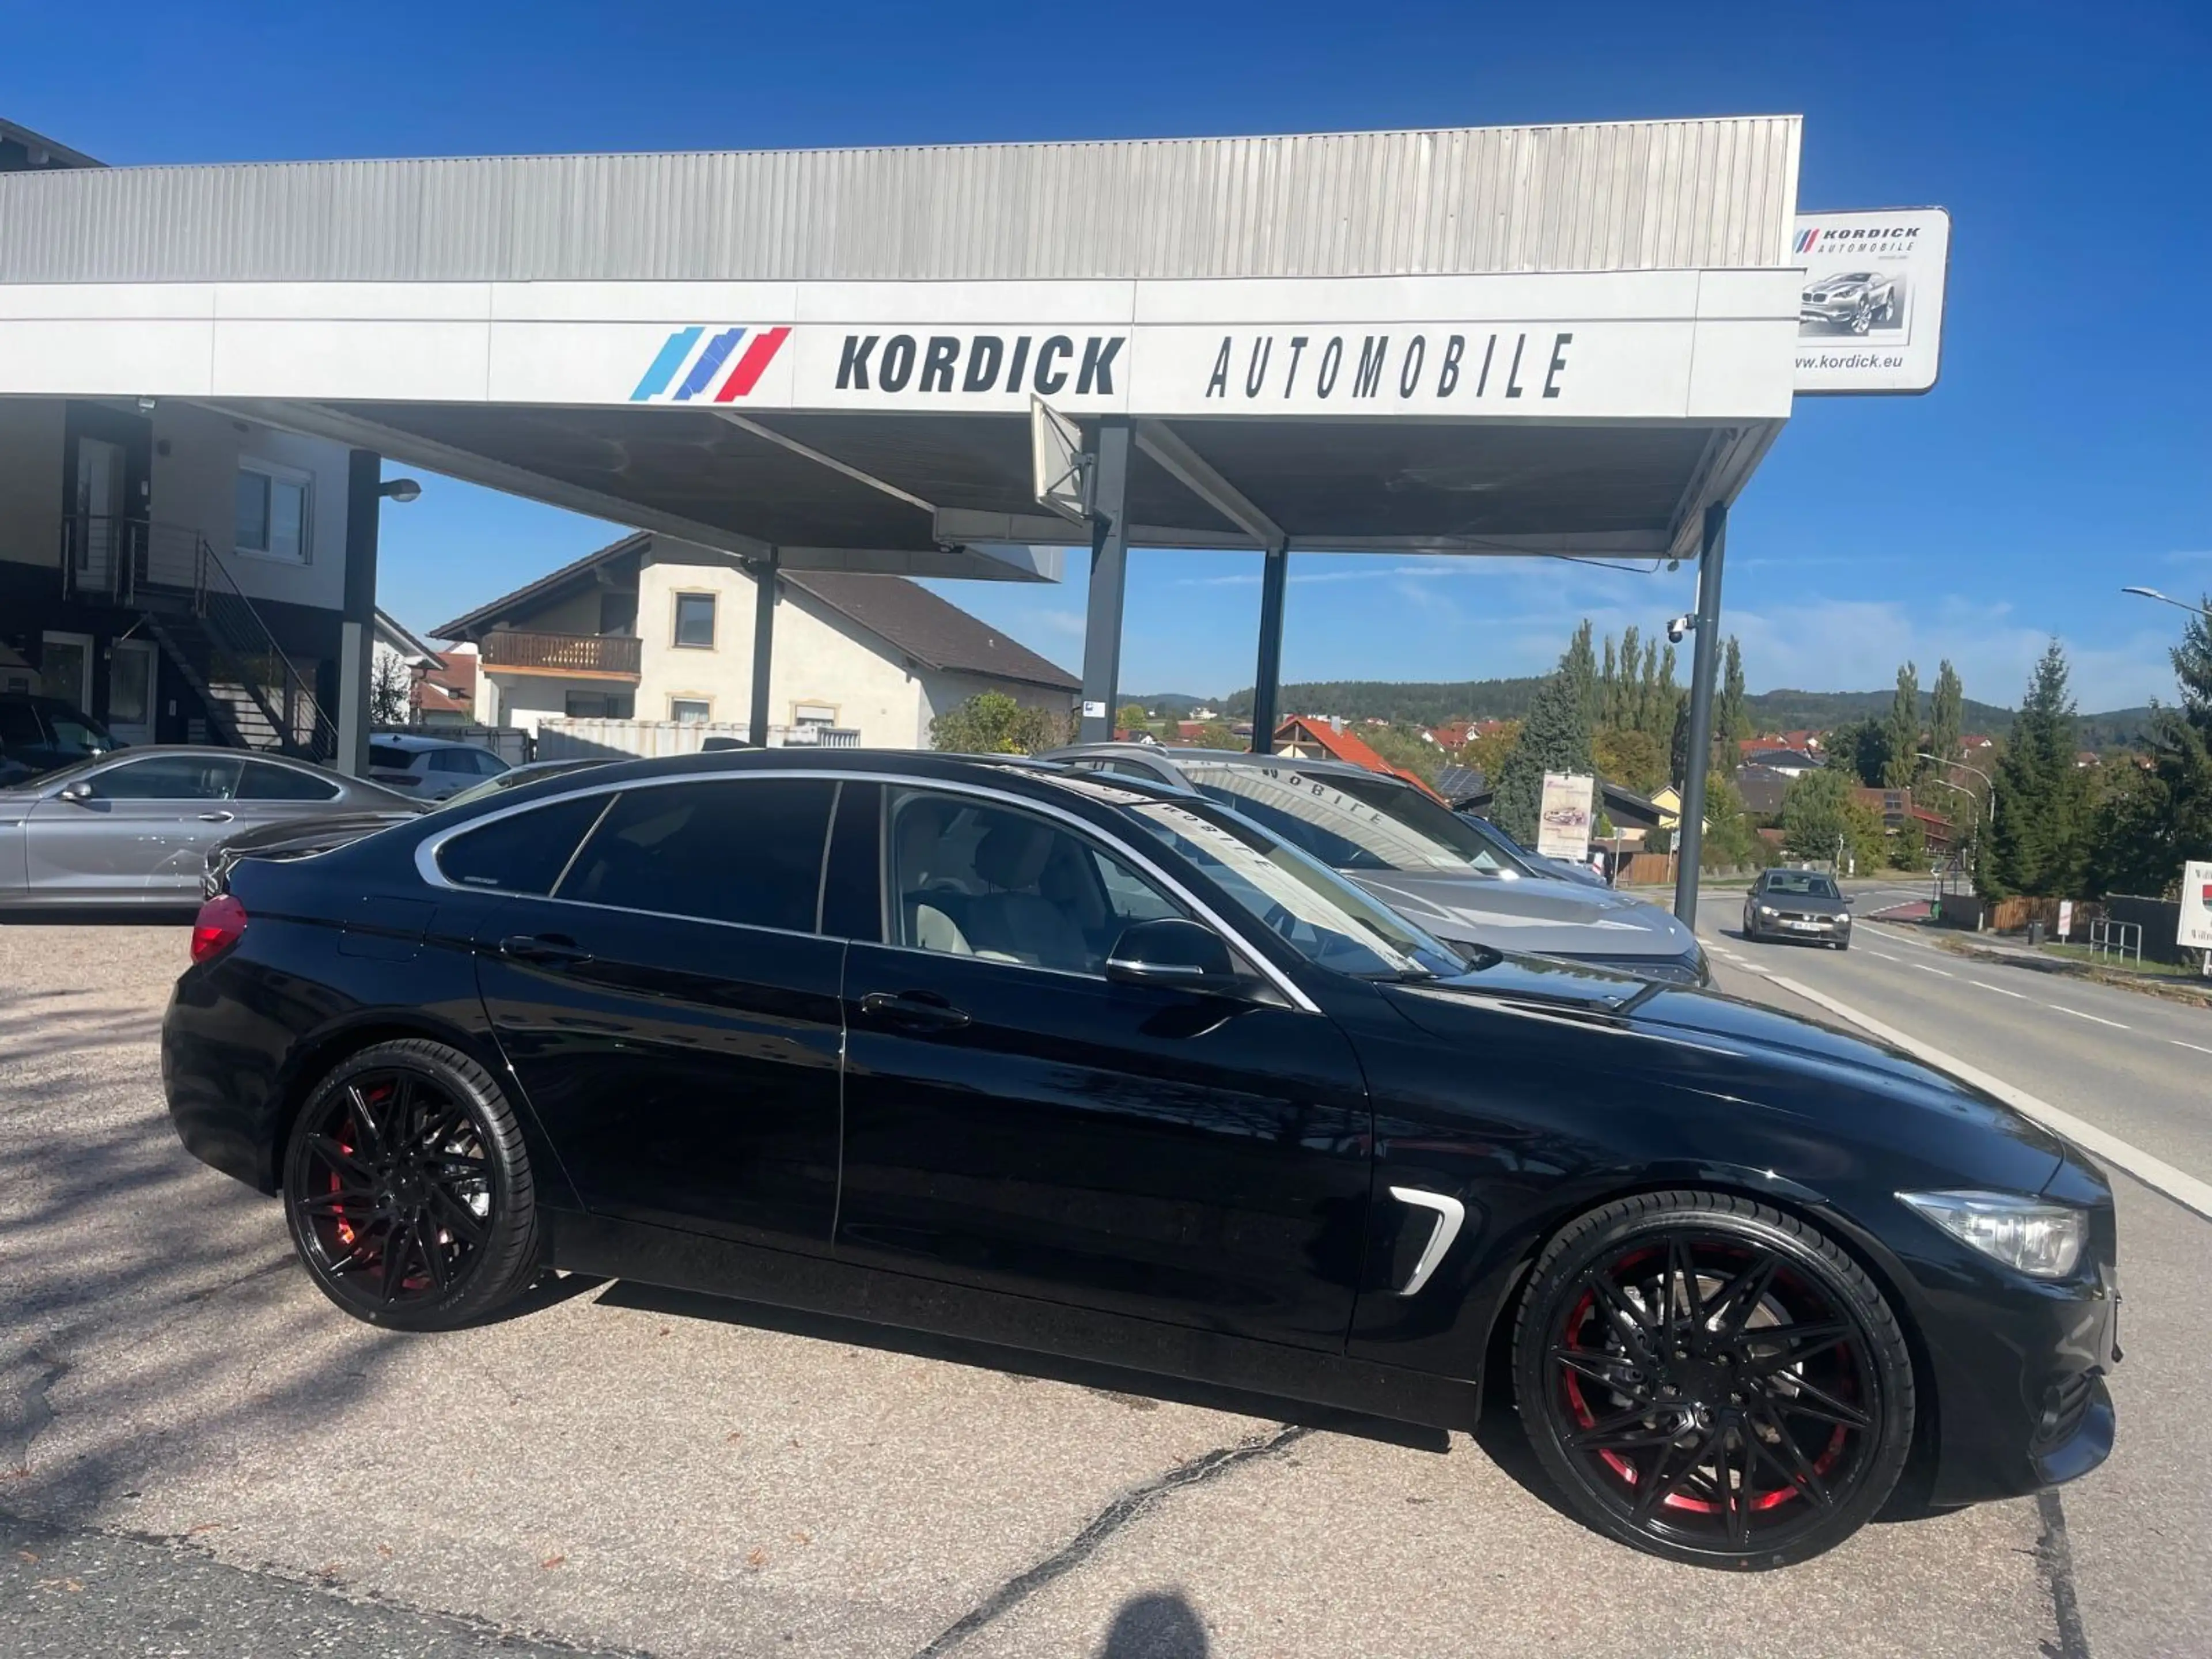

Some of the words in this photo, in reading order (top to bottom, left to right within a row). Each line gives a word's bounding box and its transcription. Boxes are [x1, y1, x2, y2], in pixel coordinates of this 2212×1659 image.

[1823, 228, 1921, 240] KORDICK
[1817, 241, 1915, 253] AUTOMOBILE
[835, 334, 1125, 395] KORDICK
[1206, 334, 1572, 399] AUTOMOBILE
